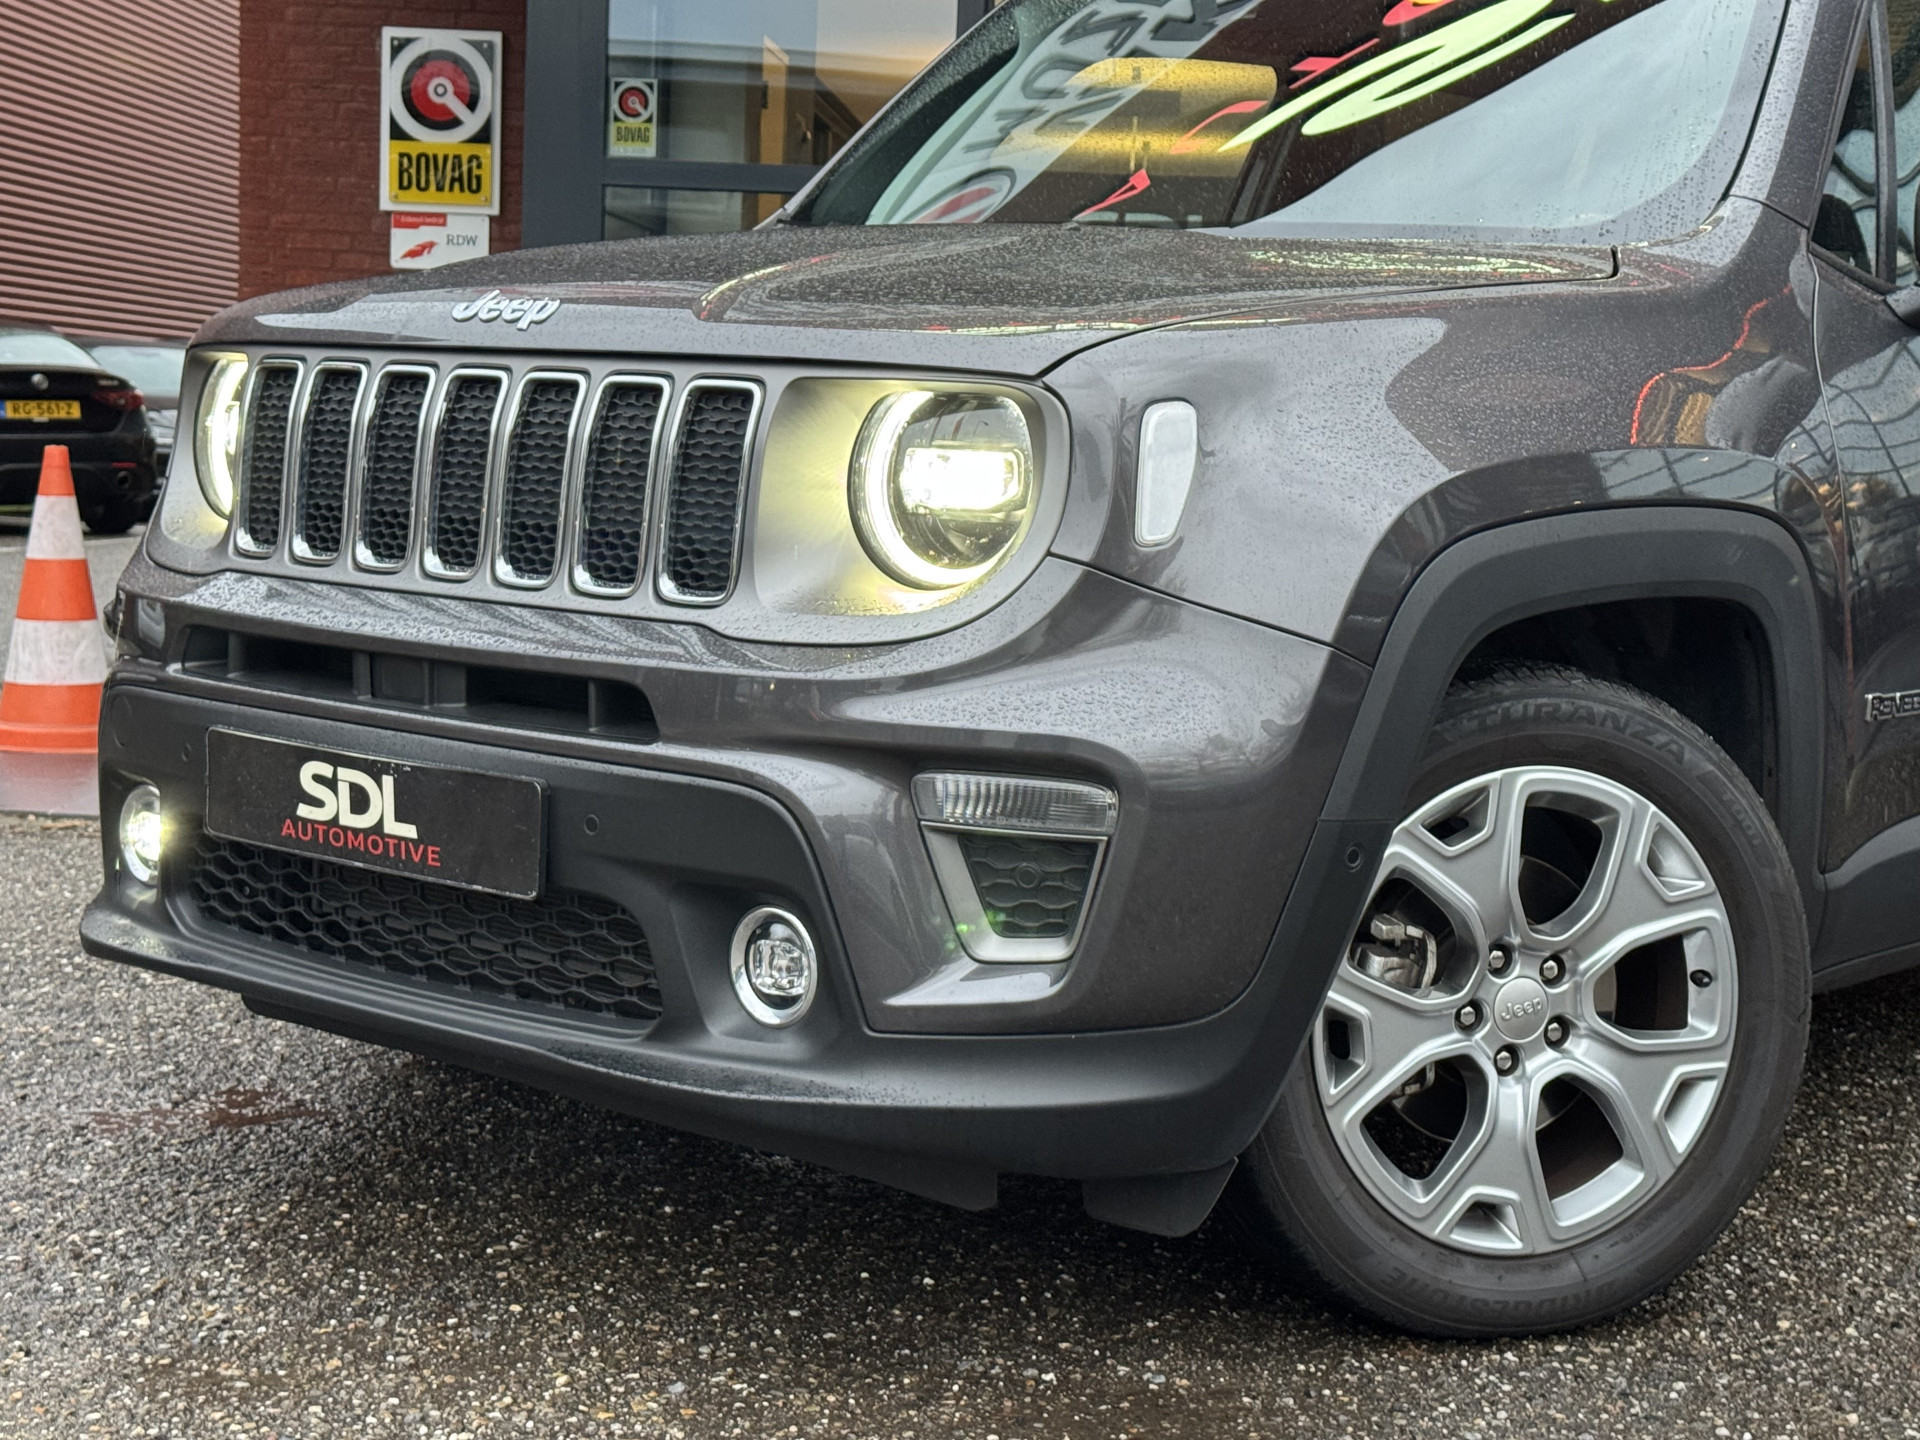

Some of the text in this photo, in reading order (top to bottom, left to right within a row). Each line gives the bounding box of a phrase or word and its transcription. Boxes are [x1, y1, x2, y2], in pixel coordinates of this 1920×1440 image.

[617, 127, 650, 143] BOVAG
[398, 152, 482, 194] BOVAG
[446, 234, 478, 247] RDW
[452, 289, 560, 331] Jeep
[1472, 700, 1688, 767] TURANZA
[297, 760, 418, 839] SDL
[282, 819, 441, 867] AUTOMOTIVE
[1501, 998, 1541, 1019] Jeep
